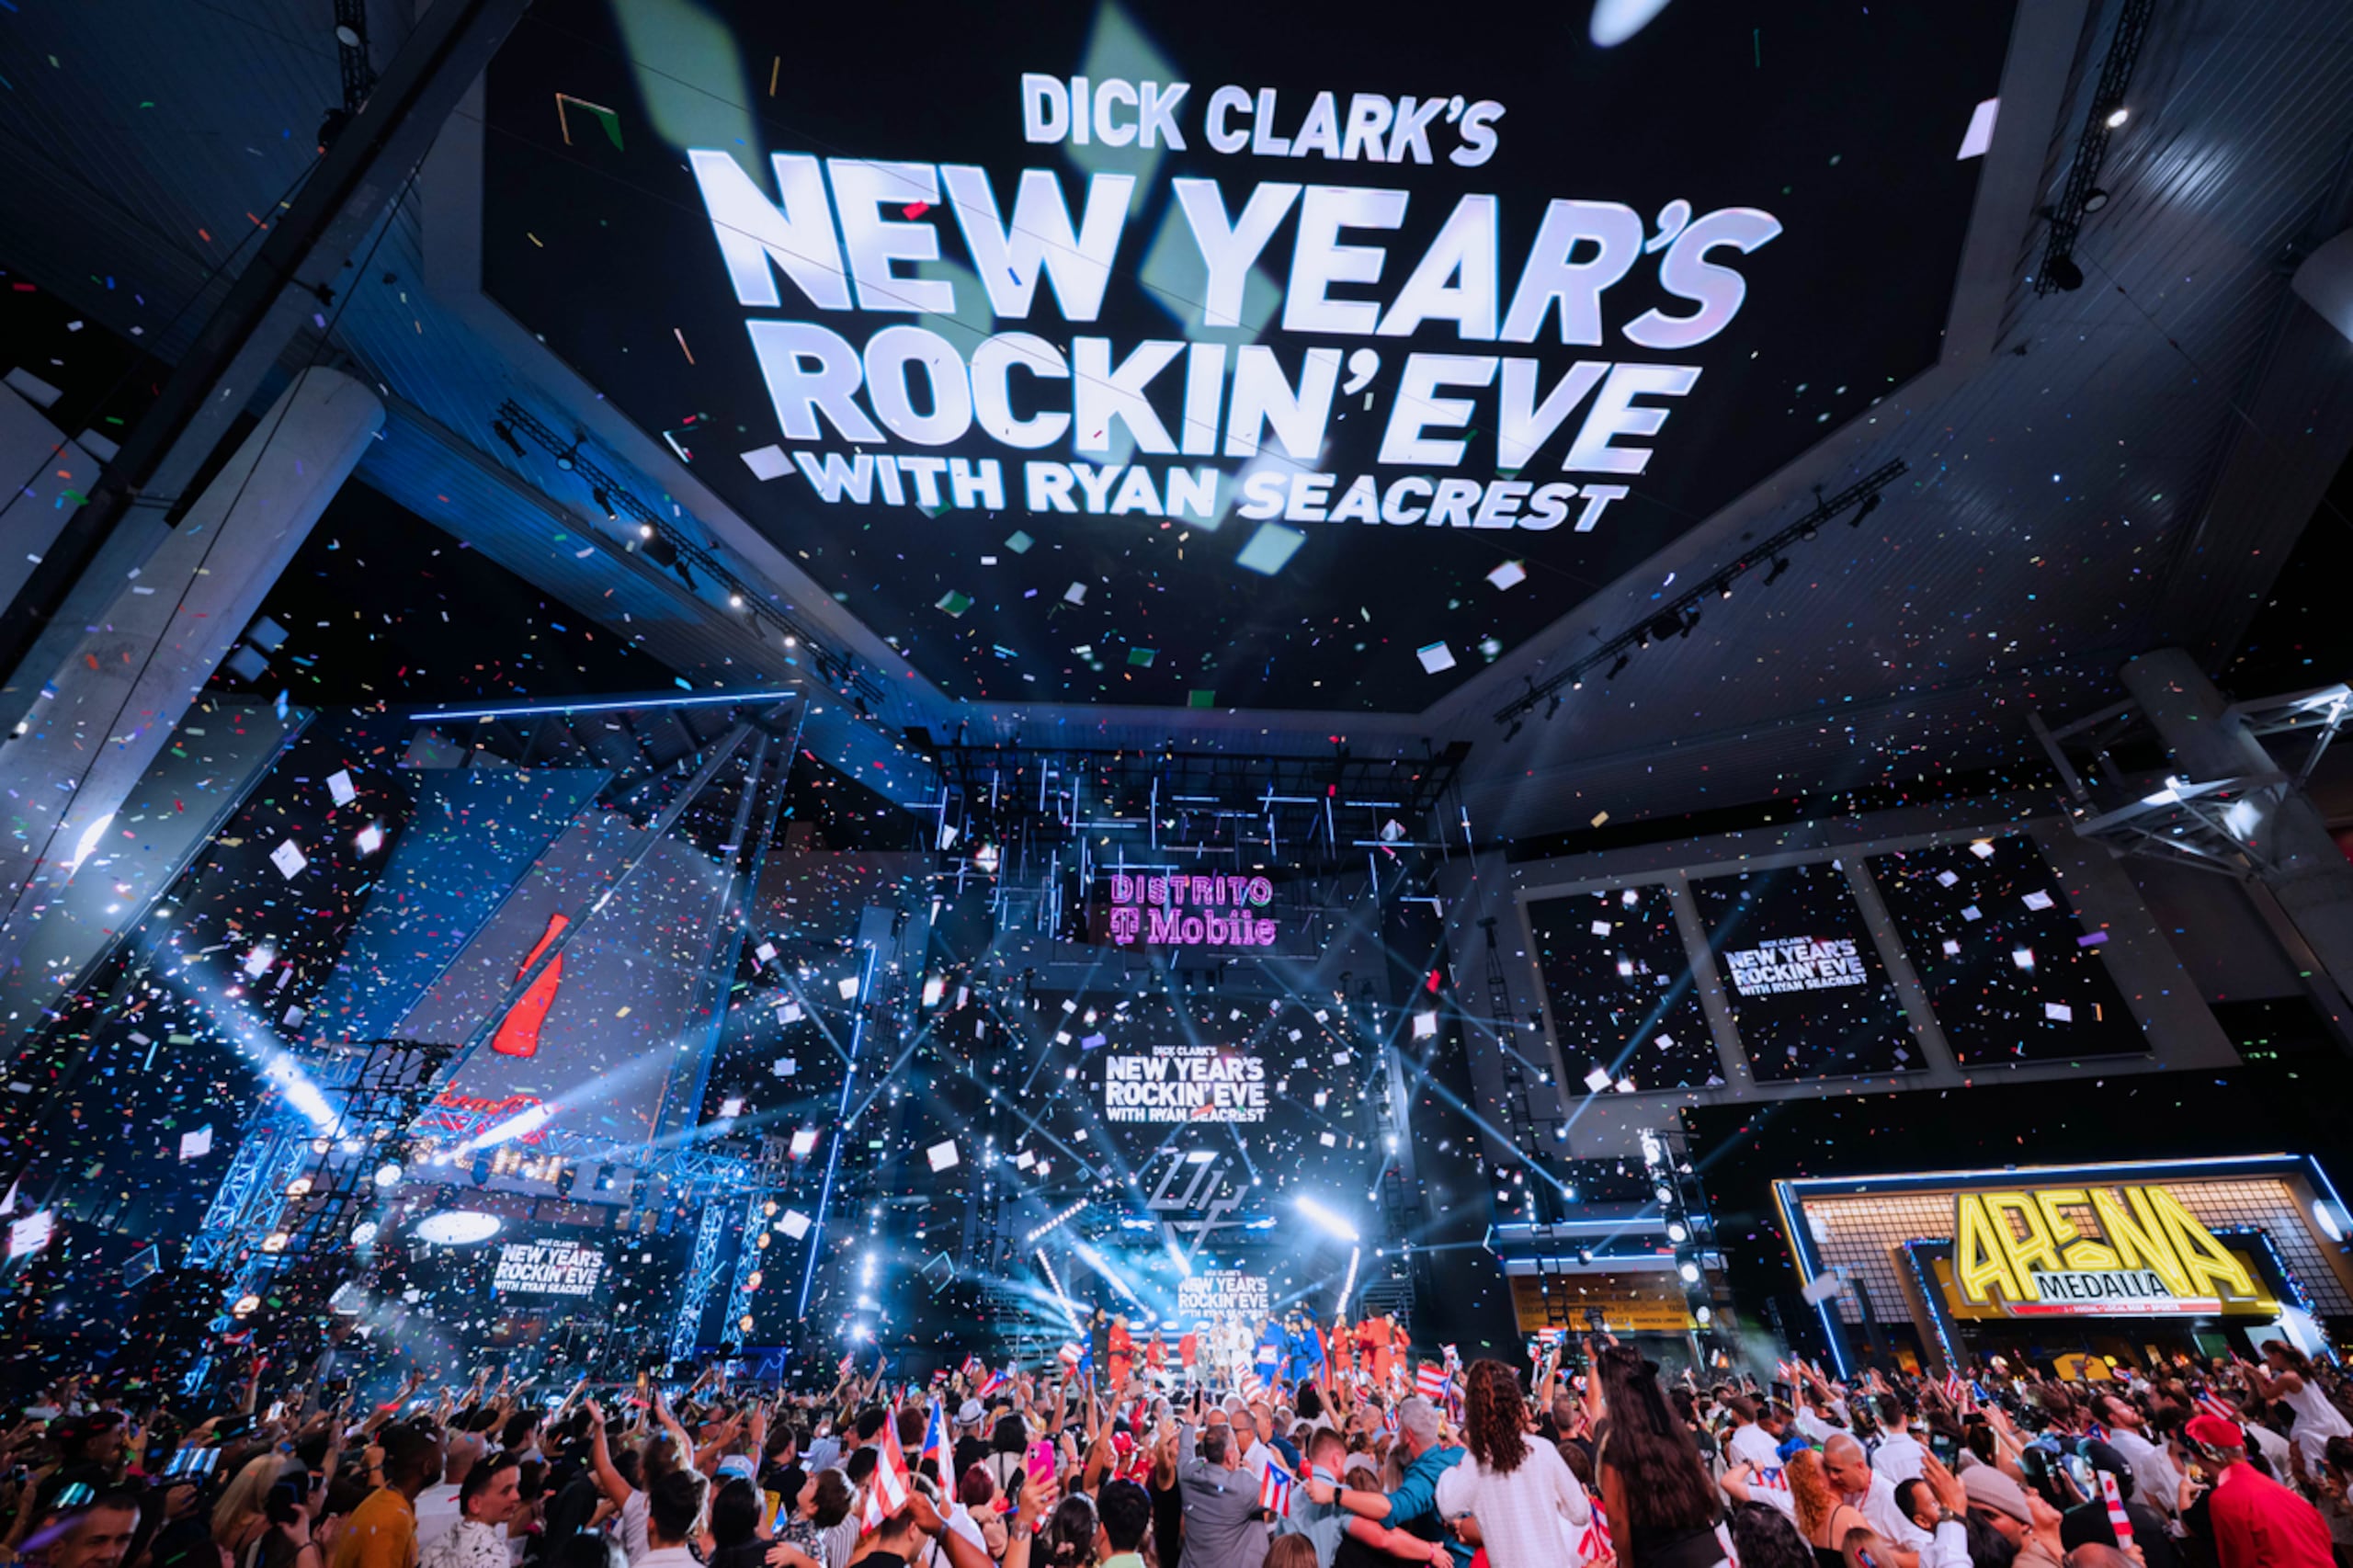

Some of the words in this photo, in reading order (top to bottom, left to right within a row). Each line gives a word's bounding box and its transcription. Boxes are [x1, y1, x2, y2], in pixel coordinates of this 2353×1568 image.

[1021, 73, 1190, 150] DICK
[1206, 85, 1506, 167] CLARK'S
[688, 150, 1136, 322] NEW
[1173, 178, 1783, 350] YEAR'S
[745, 319, 1381, 460] ROCKIN'
[1378, 353, 1702, 474] EVE
[793, 450, 1005, 511] WITH
[1027, 462, 1219, 517] RYAN
[1238, 472, 1631, 533] SEACREST
[1110, 875, 1274, 907] DISTRITO
[1147, 908, 1277, 947] Mobile
[1724, 948, 1777, 969] NEW
[1779, 938, 1858, 960] YEAR'S
[1731, 961, 1816, 986] ROCKIN'
[1817, 956, 1866, 977] EVE
[1736, 983, 1772, 997] WITH
[1772, 980, 1805, 994] RYAN
[1805, 973, 1868, 990] SEACREST
[1152, 1046, 1175, 1057] DICK
[1106, 1056, 1170, 1081] NEW
[1172, 1057, 1266, 1082] YEAR'S
[1106, 1081, 1213, 1107] ROCKIN'
[1213, 1082, 1267, 1108] EVE
[1106, 1107, 1146, 1122] WITH
[1148, 1107, 1188, 1123] RYAN
[501, 1243, 547, 1264] NEW
[548, 1247, 604, 1267] YEAR'S
[1954, 1187, 2256, 1302] ARENA
[494, 1261, 566, 1282] ROCKIN'
[564, 1267, 600, 1285] EVE
[1178, 1277, 1213, 1292] NEW
[1215, 1277, 1268, 1293] YEAR'S
[2038, 1272, 2170, 1300] MEDALLA
[1178, 1292, 1238, 1309] ROCKIN'
[1238, 1292, 1268, 1308] EVE
